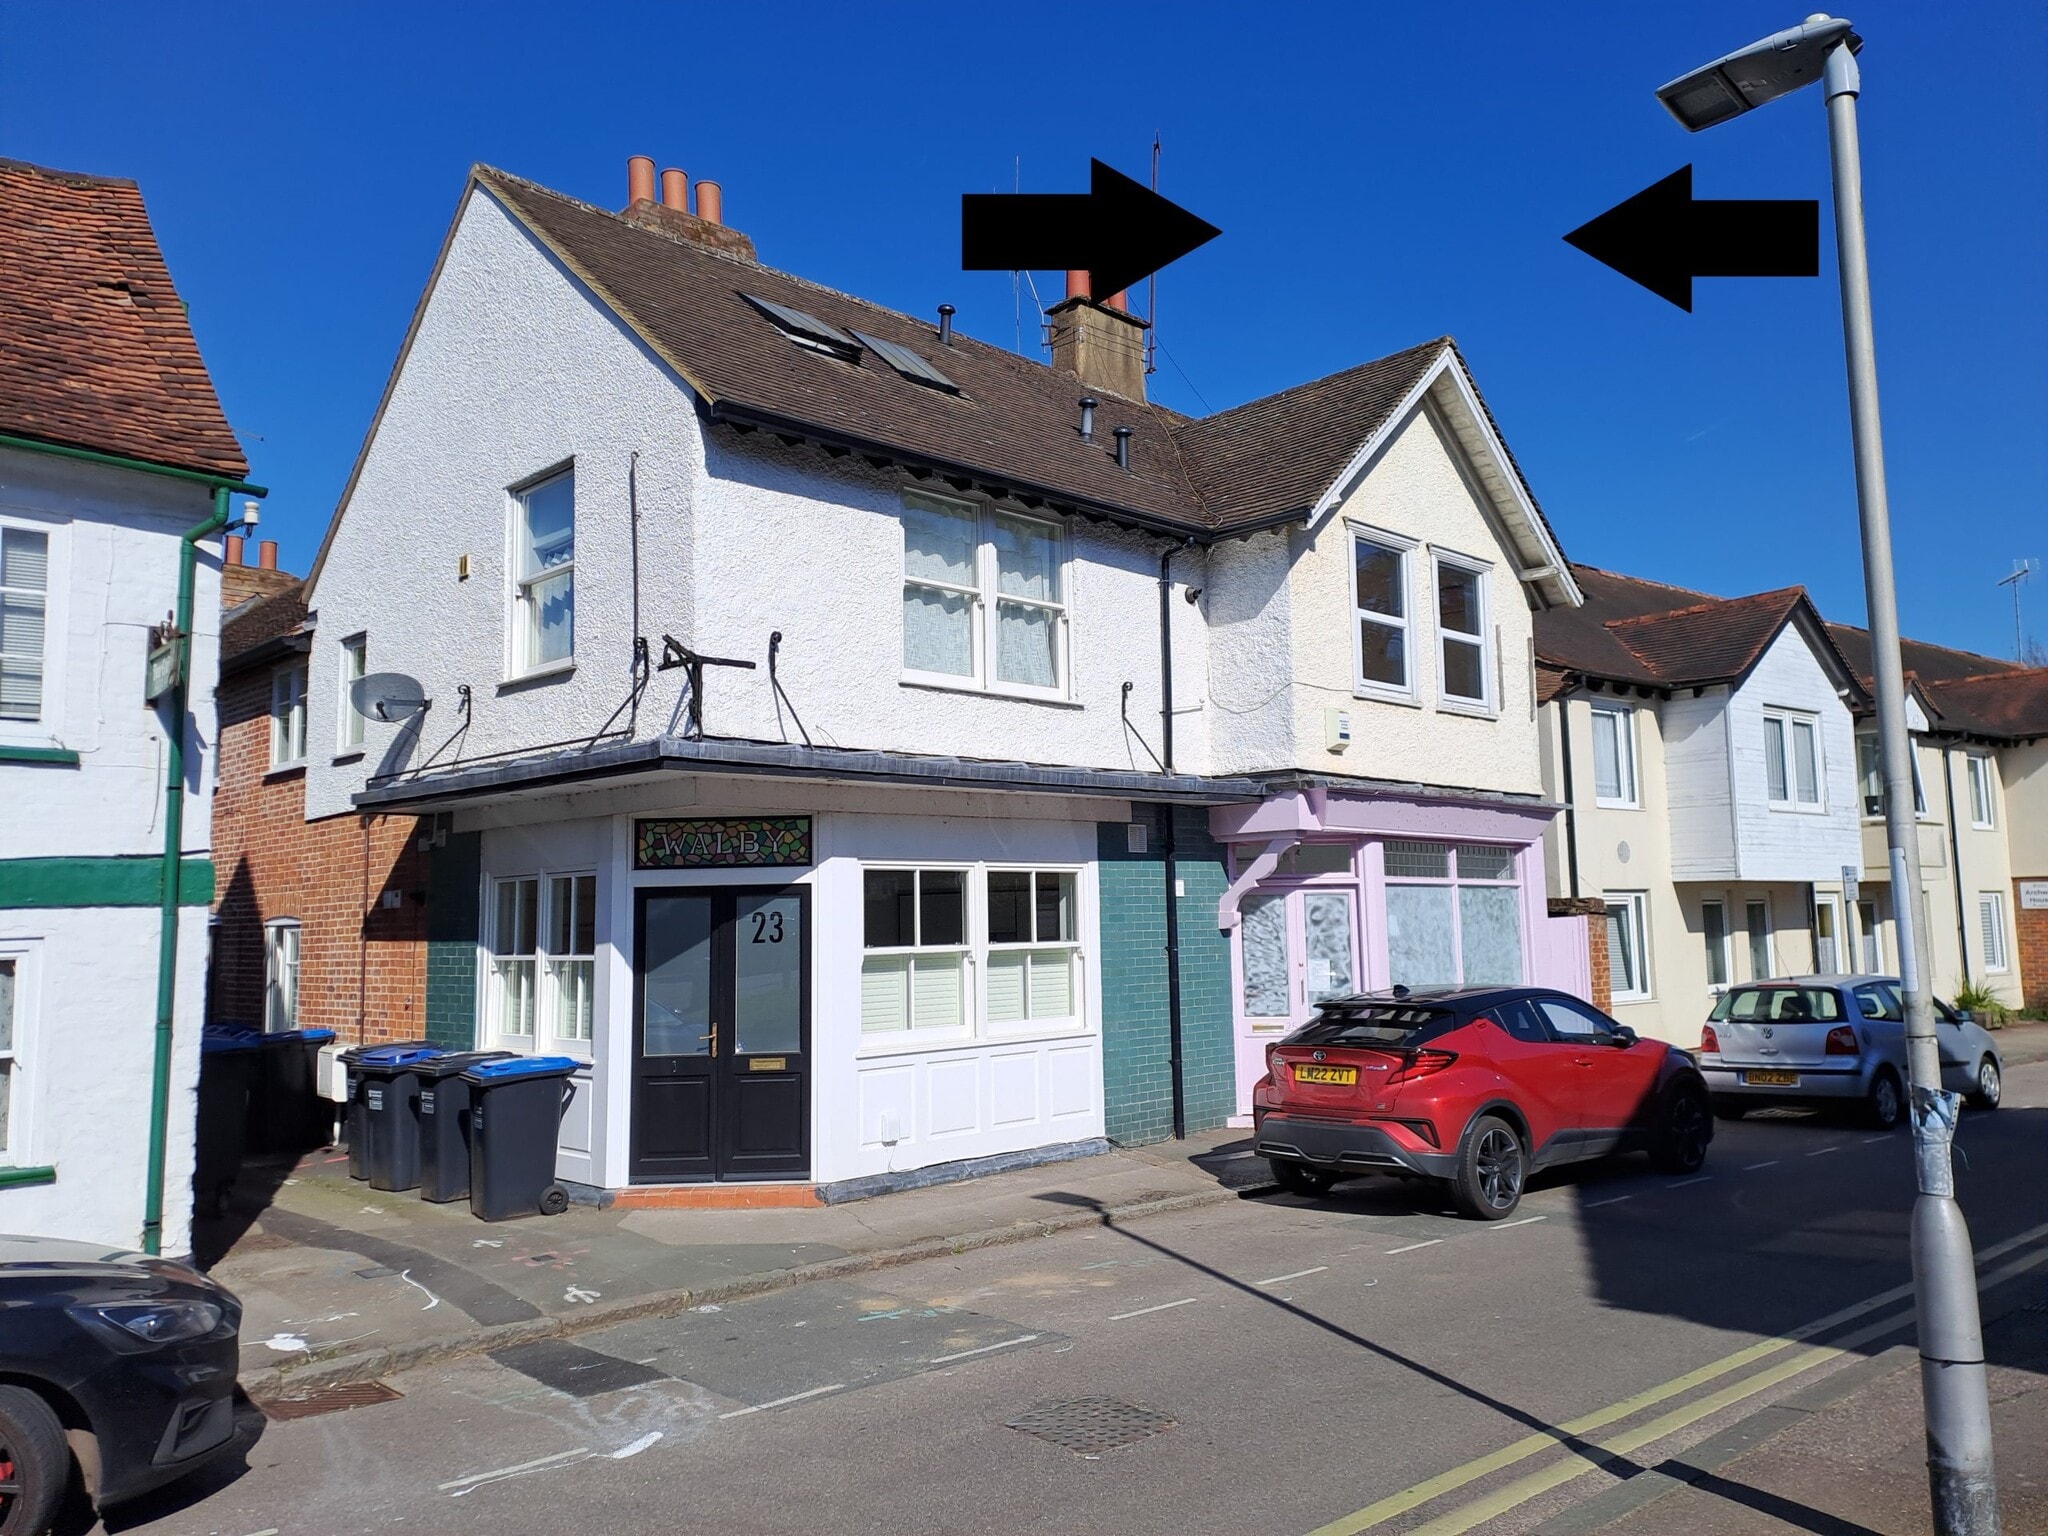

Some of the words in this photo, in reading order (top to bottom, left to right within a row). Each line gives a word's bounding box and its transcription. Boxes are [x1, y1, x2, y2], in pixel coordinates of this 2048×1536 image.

[661, 830, 786, 855] WALBY
[752, 911, 784, 944] 23
[1330, 1068, 1353, 1083] ZVT
